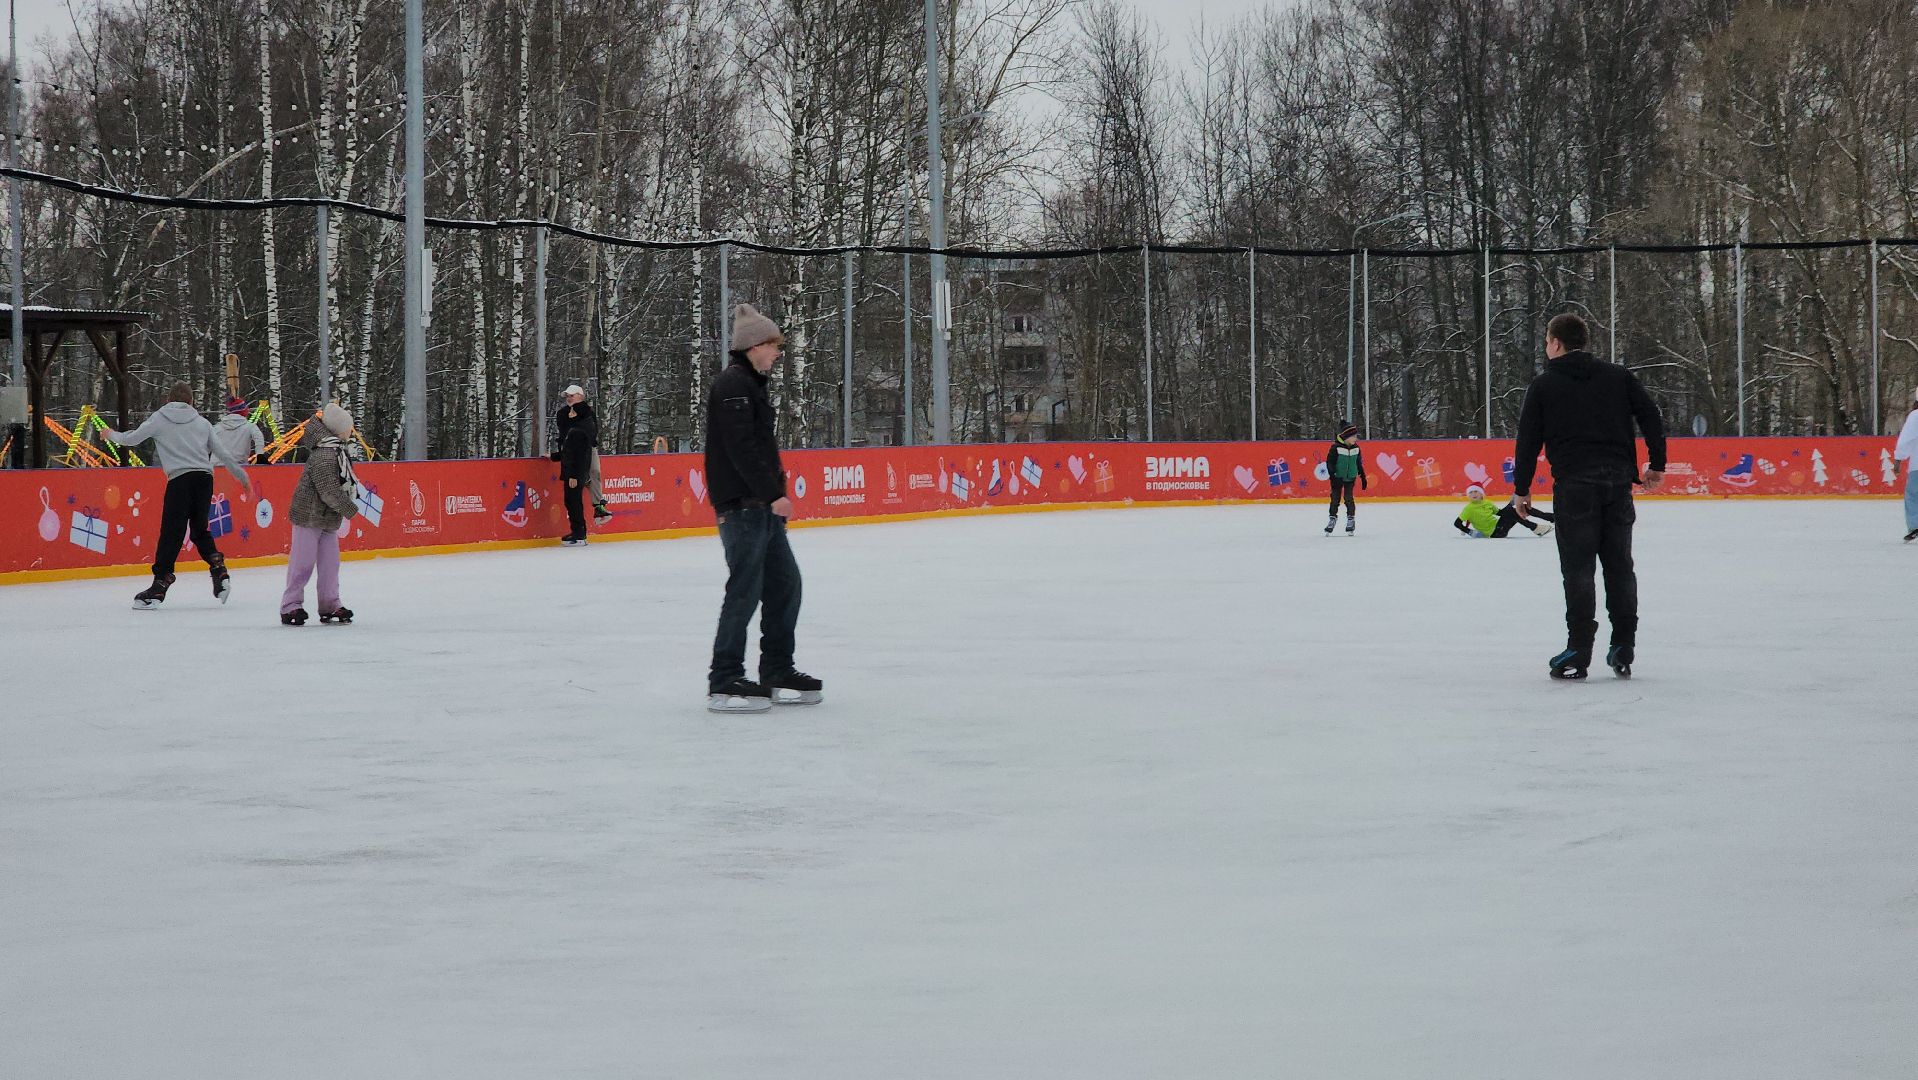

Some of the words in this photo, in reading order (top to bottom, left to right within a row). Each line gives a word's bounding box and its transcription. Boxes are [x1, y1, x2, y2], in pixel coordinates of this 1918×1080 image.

[1145, 456, 1210, 478] ЗИМА
[604, 475, 643, 489] КАТАЙТЕСЬ
[824, 464, 865, 491] ЗИМА
[1152, 481, 1210, 491] ПОДМОСКОВЬЕ
[601, 491, 655, 505] ДОВОЛЬСТВИЕМ!
[829, 494, 866, 506] ПОДМОСКОВЬЕ
